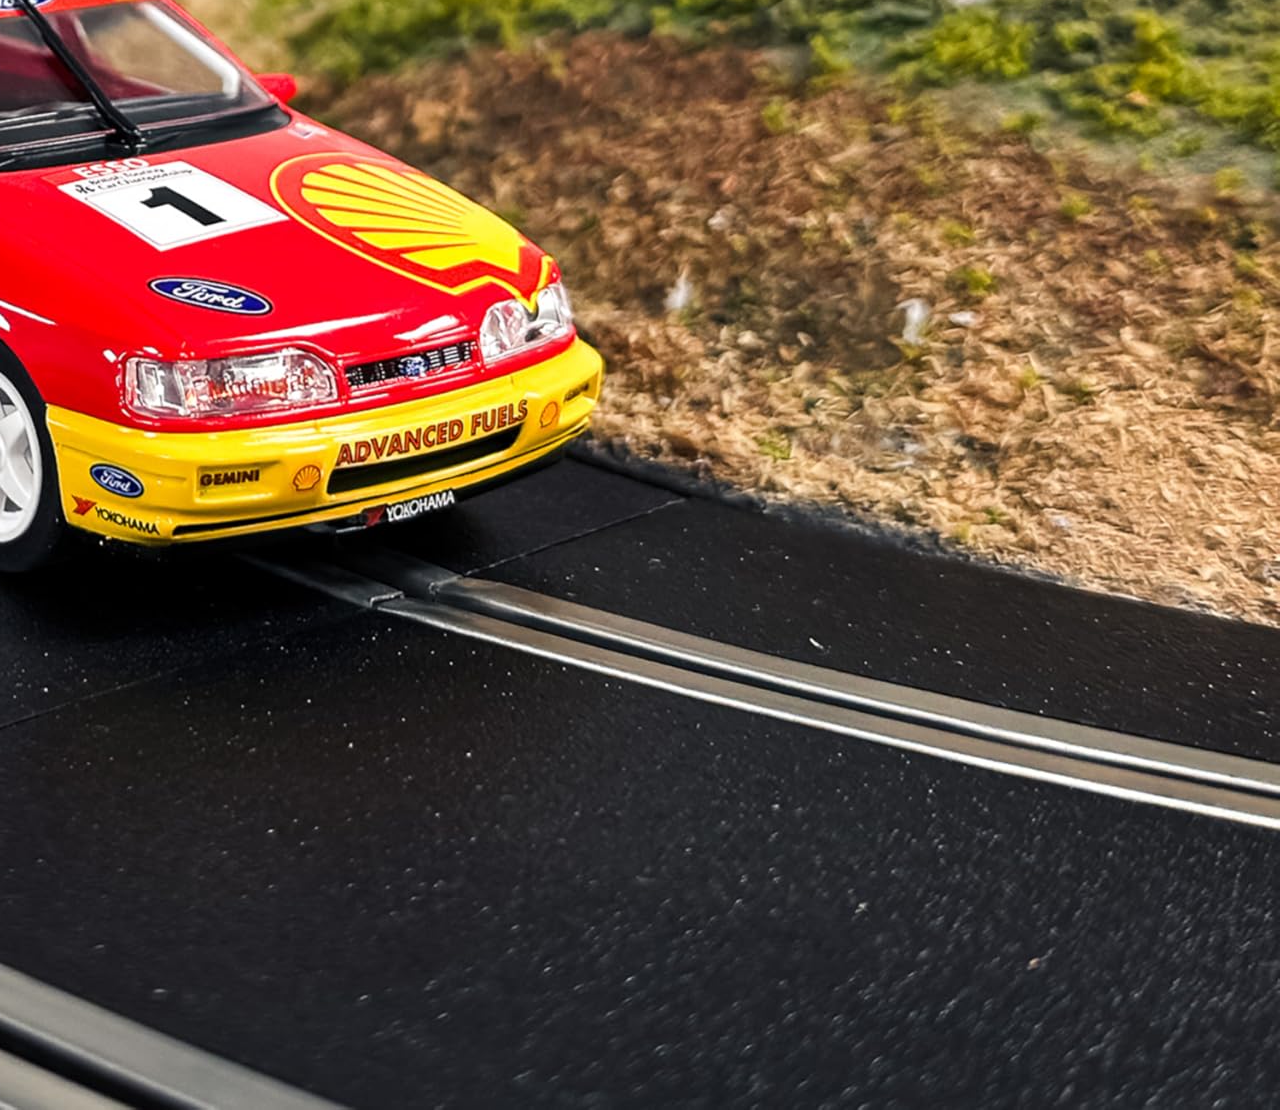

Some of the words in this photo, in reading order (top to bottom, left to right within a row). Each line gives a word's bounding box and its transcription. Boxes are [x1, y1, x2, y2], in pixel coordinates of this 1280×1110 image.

[71, 157, 151, 179] ESSO
[139, 186, 228, 227] 1
[172, 281, 248, 308] Ford
[335, 419, 464, 467] ADVANCED
[470, 399, 529, 437] FUELS
[99, 470, 132, 493] Ford
[200, 469, 260, 487] GEMINI
[386, 490, 456, 522] YOKOHAMA
[94, 506, 160, 536] YOKOHAMA
